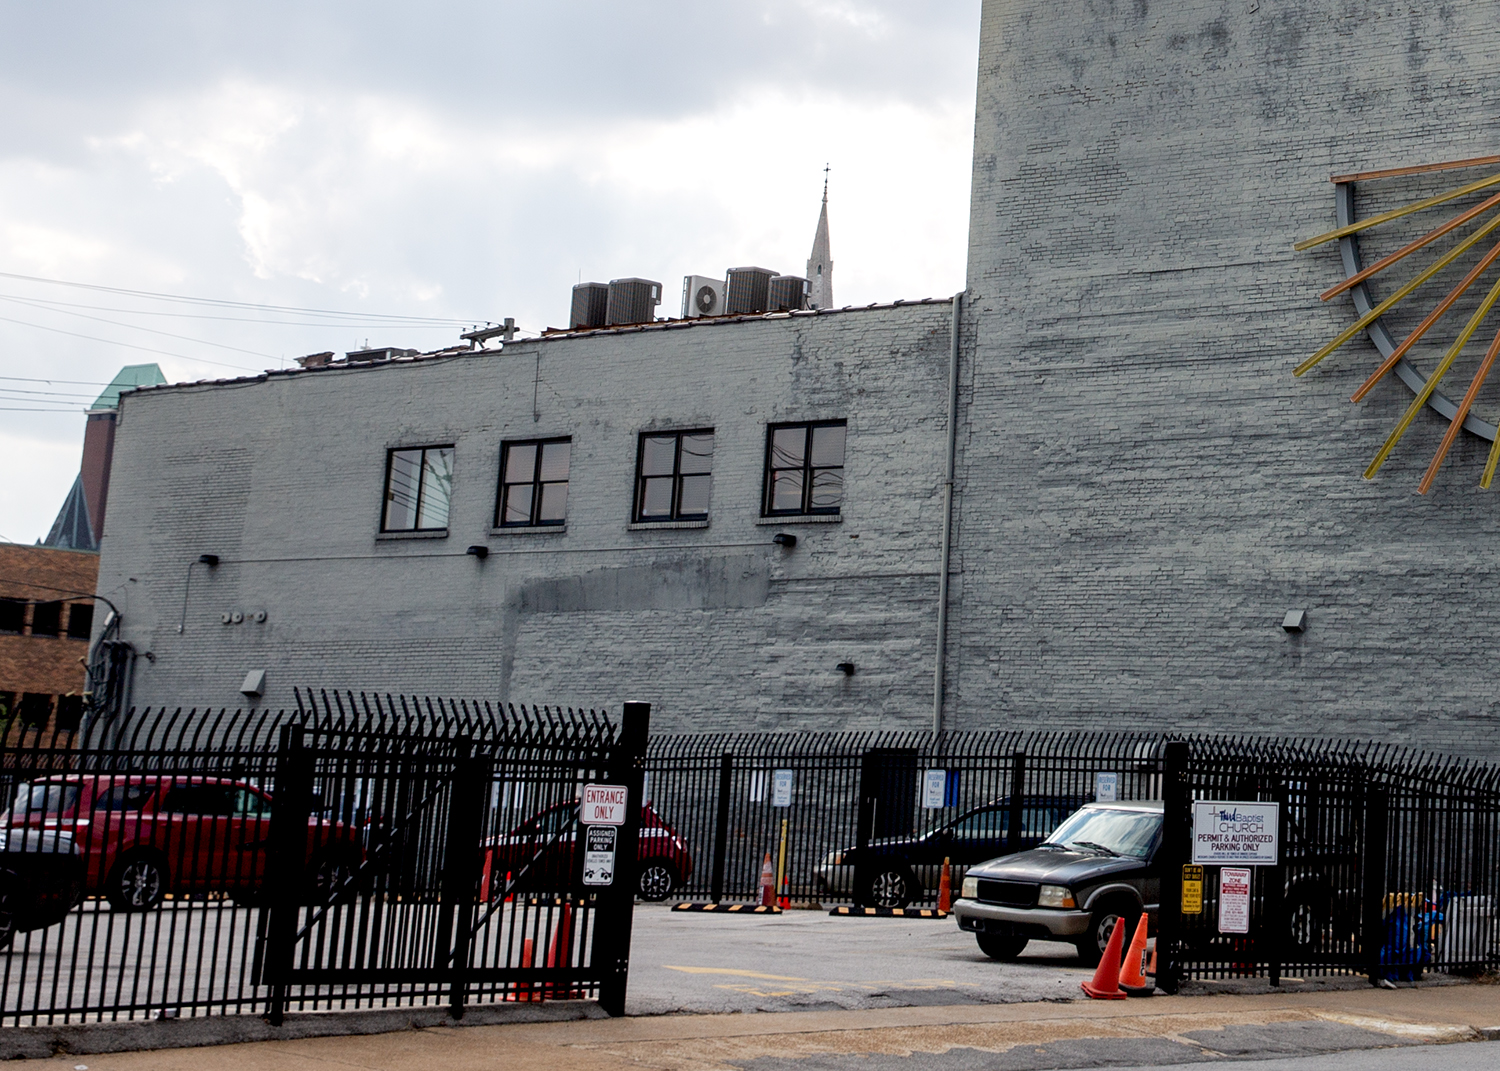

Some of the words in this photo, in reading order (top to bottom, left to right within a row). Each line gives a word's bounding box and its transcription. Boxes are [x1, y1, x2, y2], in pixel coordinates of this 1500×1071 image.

[586, 789, 625, 804] ENTRANCE
[594, 805, 614, 819] ONLY
[1219, 807, 1237, 822] Third
[1236, 813, 1264, 823] Baptist
[1219, 822, 1264, 833] CHURCH
[589, 829, 615, 837] ASSIGNED
[590, 836, 613, 844] PARKING
[1197, 834, 1223, 842] PERMIT
[1224, 834, 1229, 842] &
[1231, 834, 1273, 843] AUTHORIZED
[1211, 843, 1240, 851] PARKING
[1242, 843, 1260, 851] ONLY
